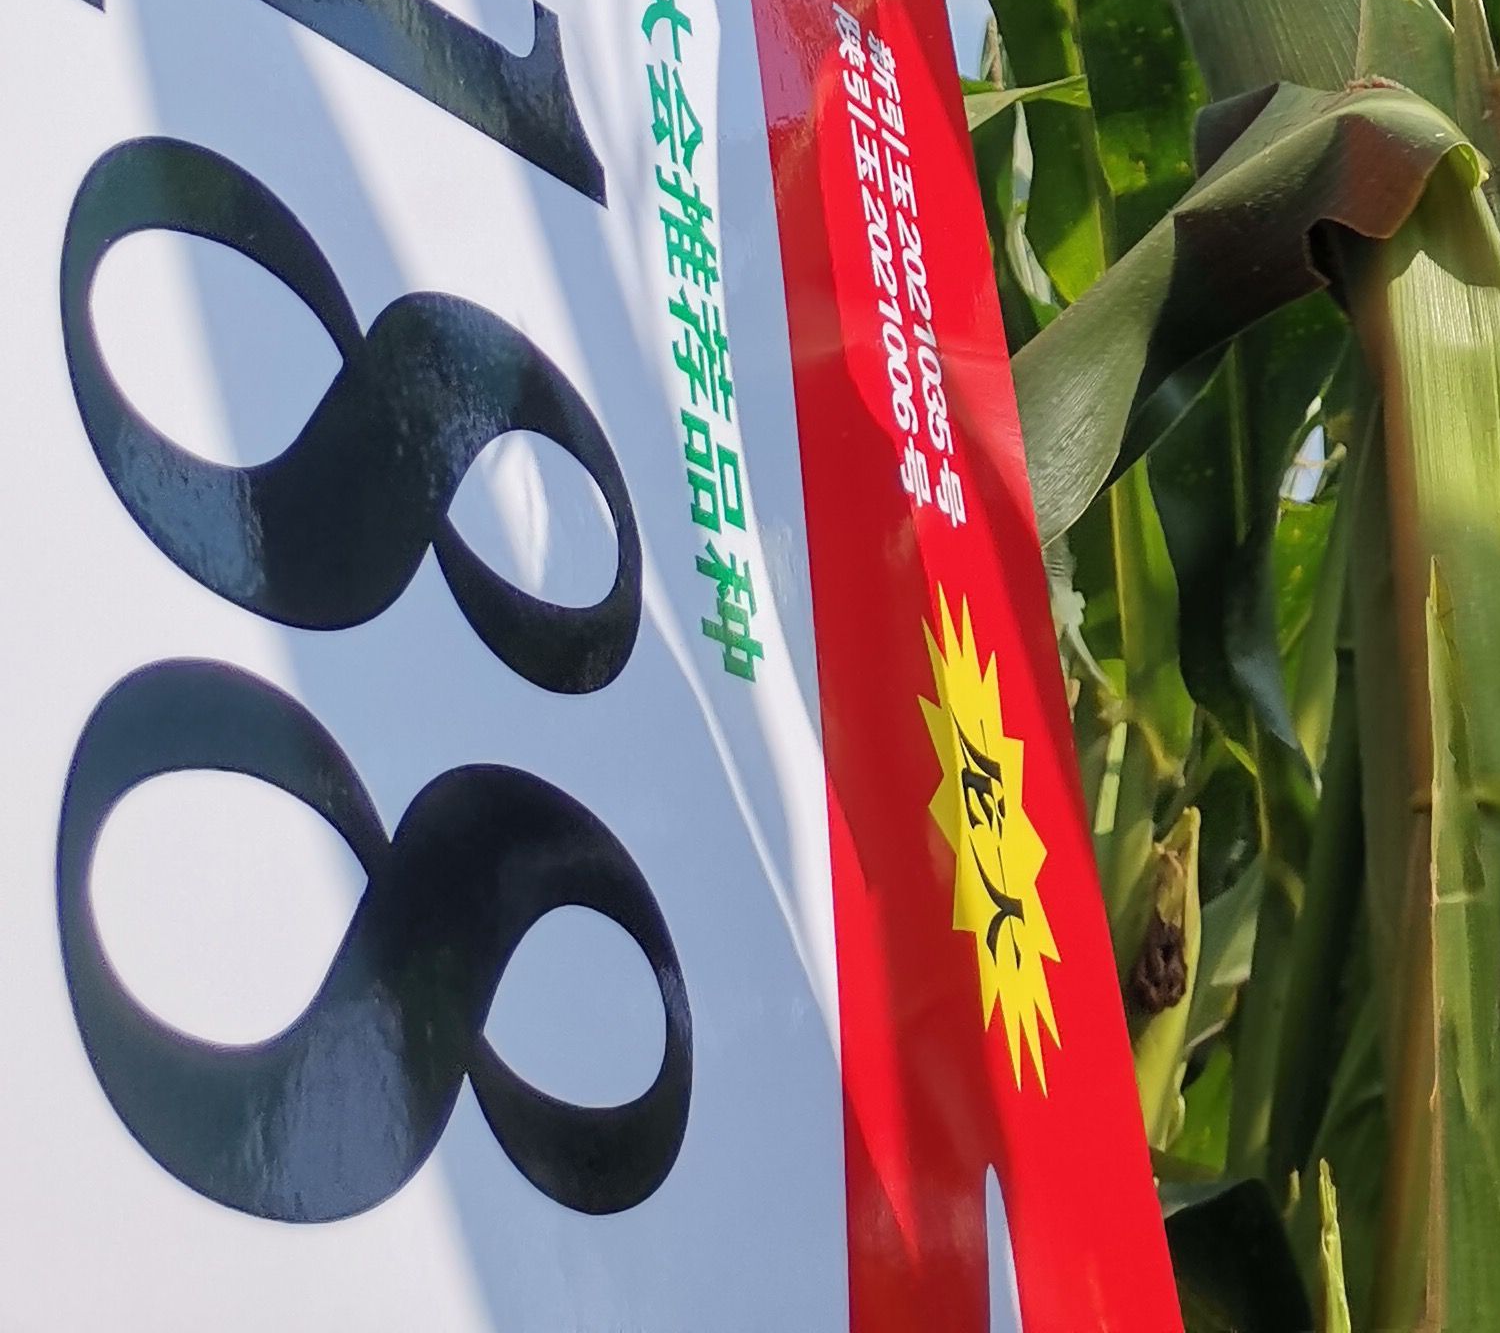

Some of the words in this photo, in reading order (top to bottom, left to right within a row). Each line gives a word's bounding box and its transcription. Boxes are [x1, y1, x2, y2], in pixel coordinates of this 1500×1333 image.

[832, 1, 931, 509] 陕引玉2021006号
[867, 30, 967, 528] 新引玉2021035号
